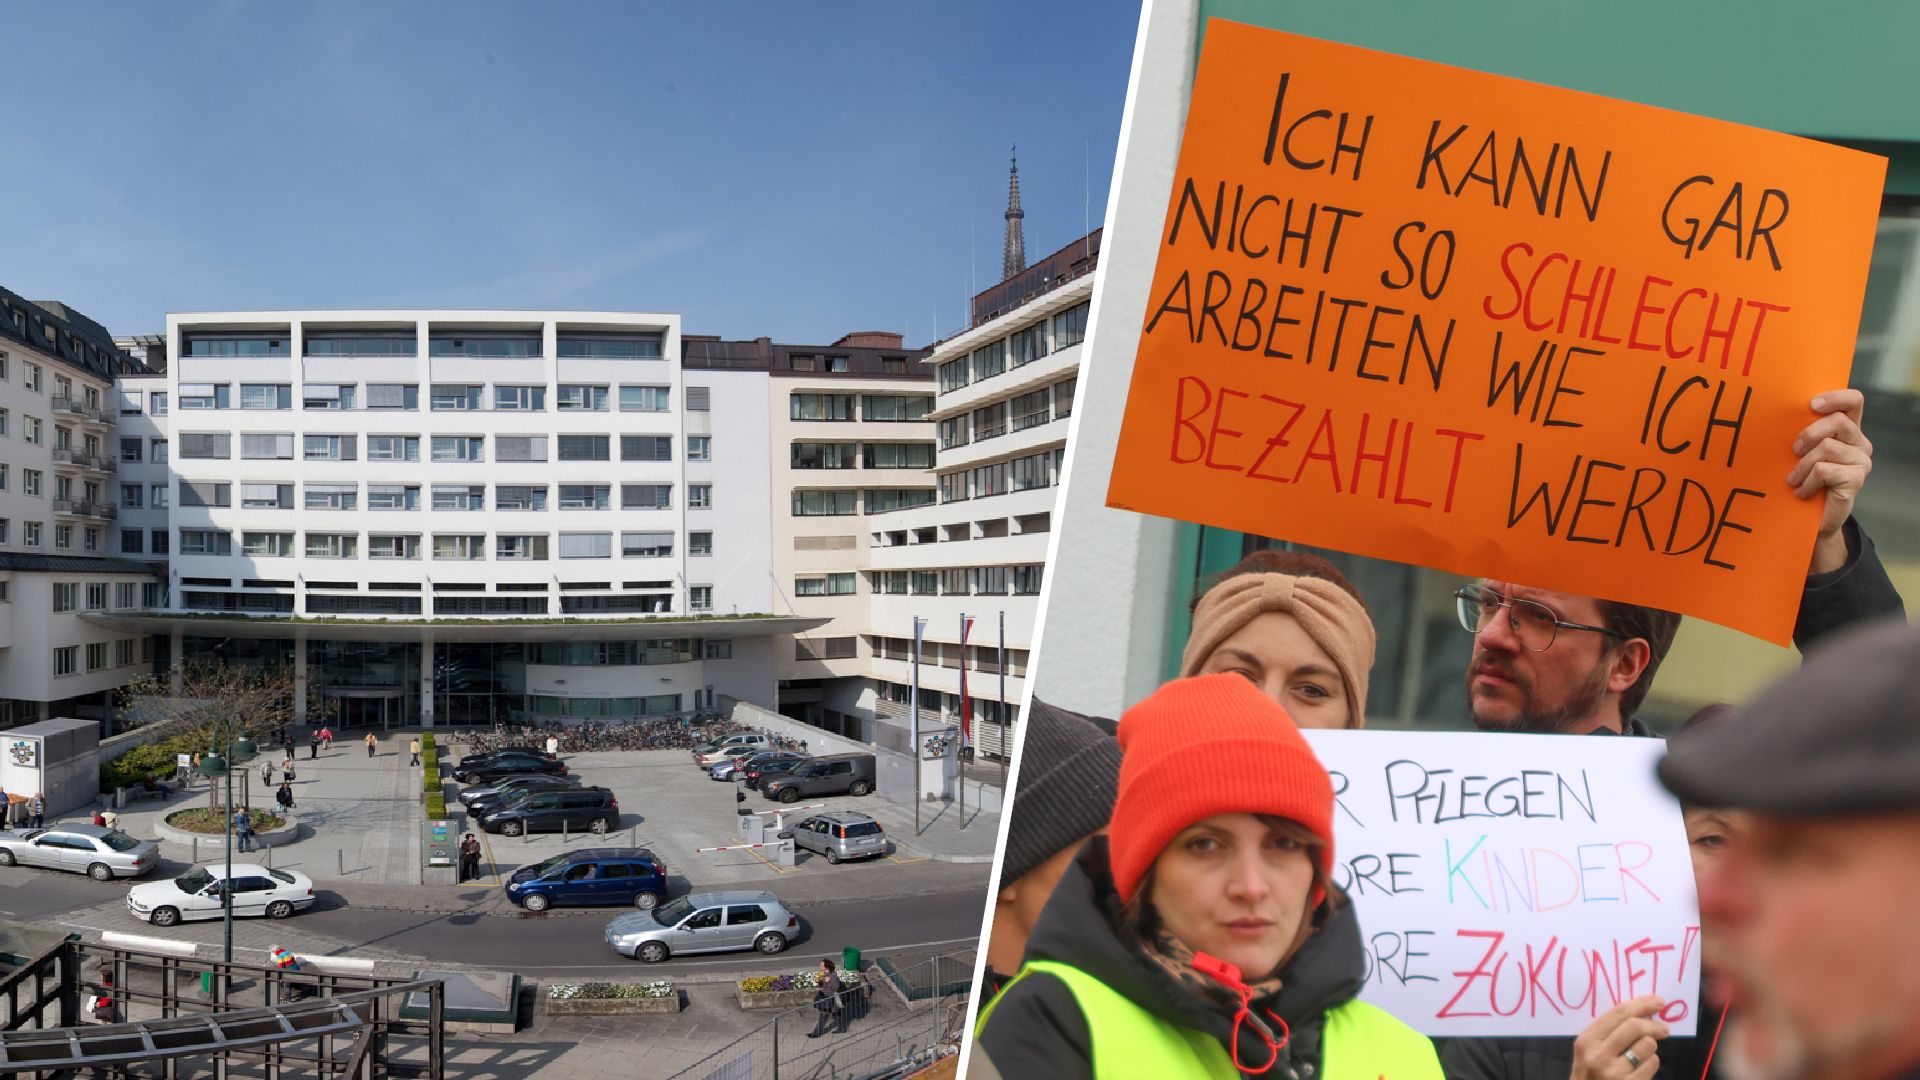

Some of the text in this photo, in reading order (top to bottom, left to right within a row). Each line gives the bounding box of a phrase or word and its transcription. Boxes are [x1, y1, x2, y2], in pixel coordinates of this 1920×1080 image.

[1263, 73, 1790, 271] ICH KANN GAR
[1146, 270, 1752, 467] ARBEITEN WIE ICH
[1168, 177, 1790, 376] NICHT SO SCHLECHT
[1170, 377, 1765, 571] BEZAHLT WERDE
[1385, 760, 1596, 824] PFLEGEN
[1445, 835, 1660, 913] KINDER
